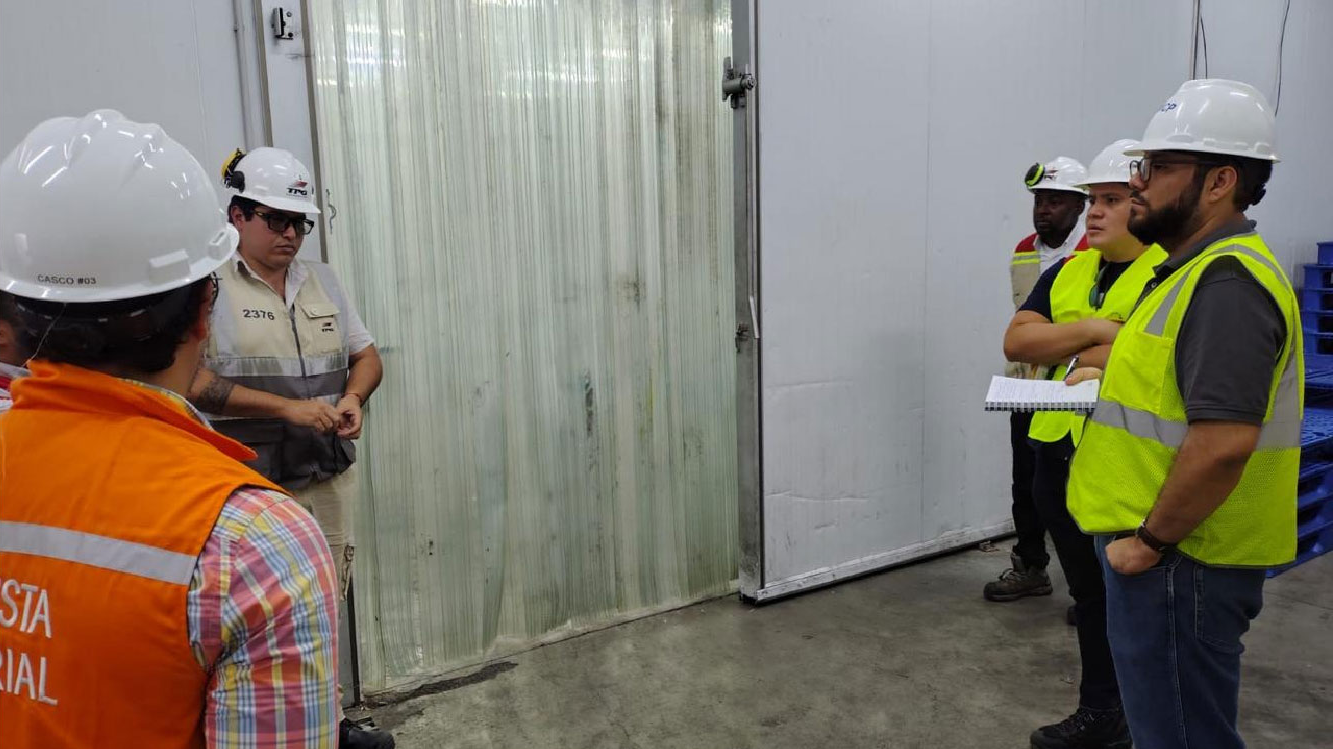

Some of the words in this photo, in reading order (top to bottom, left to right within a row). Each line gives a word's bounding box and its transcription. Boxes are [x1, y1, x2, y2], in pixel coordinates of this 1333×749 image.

[37, 274, 74, 285] CASCO
[243, 309, 275, 321] 2376
[0, 579, 51, 638] STA
